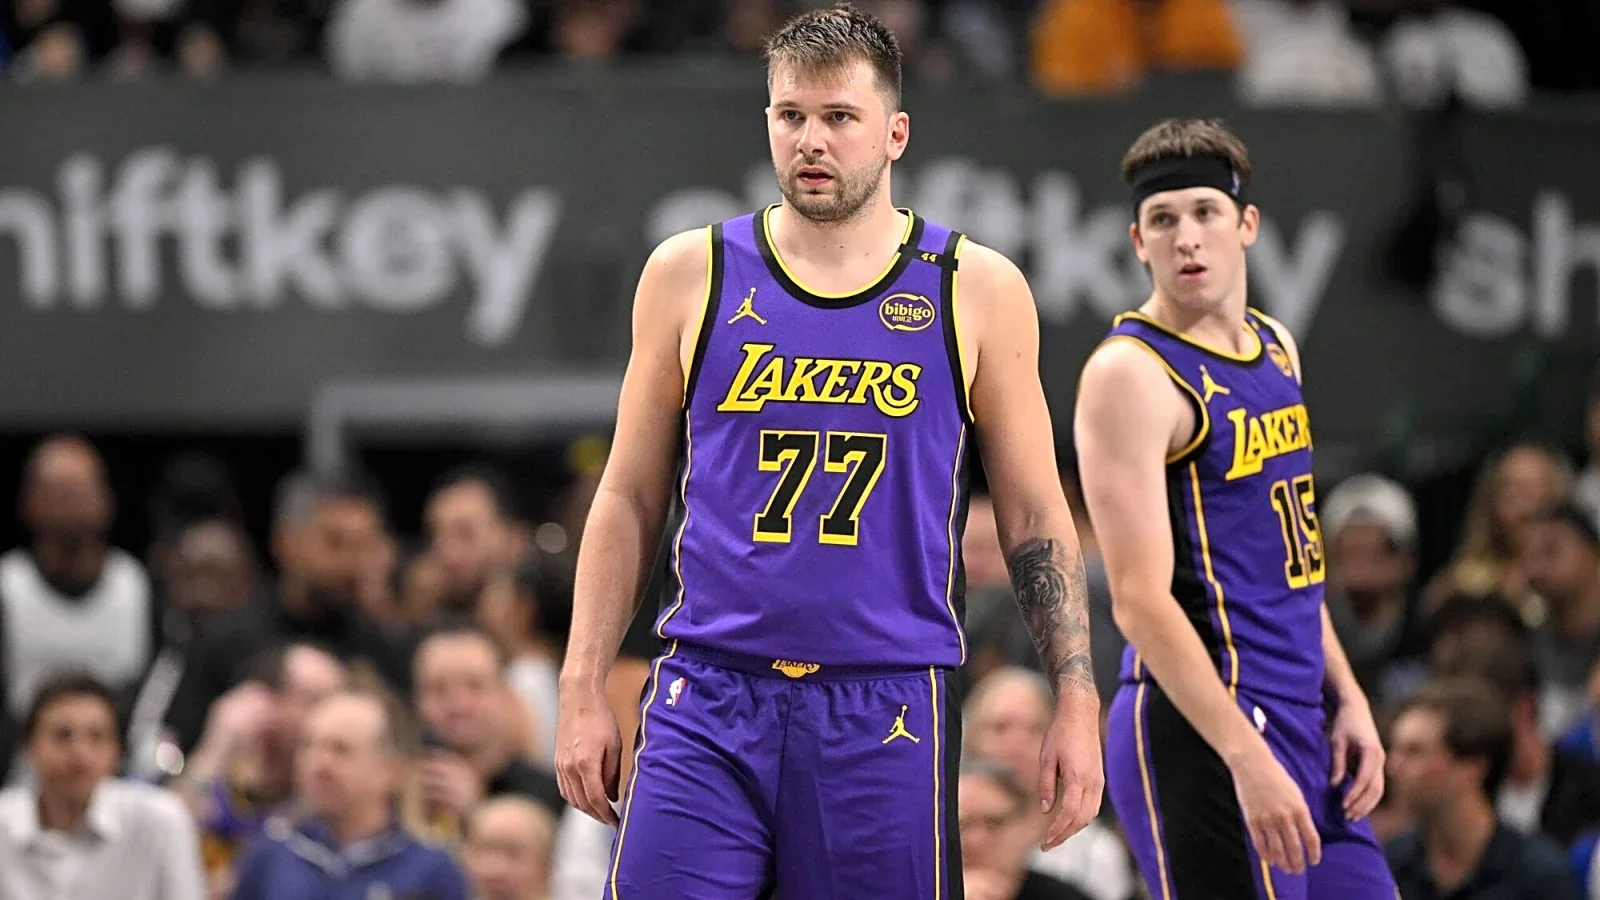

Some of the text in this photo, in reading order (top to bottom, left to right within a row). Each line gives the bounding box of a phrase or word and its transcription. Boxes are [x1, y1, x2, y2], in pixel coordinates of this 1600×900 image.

[920, 252, 938, 263] 44
[884, 302, 932, 321] bibigo
[716, 342, 923, 417] LAKERS
[752, 429, 888, 546] 77
[1270, 473, 1326, 590] 15
